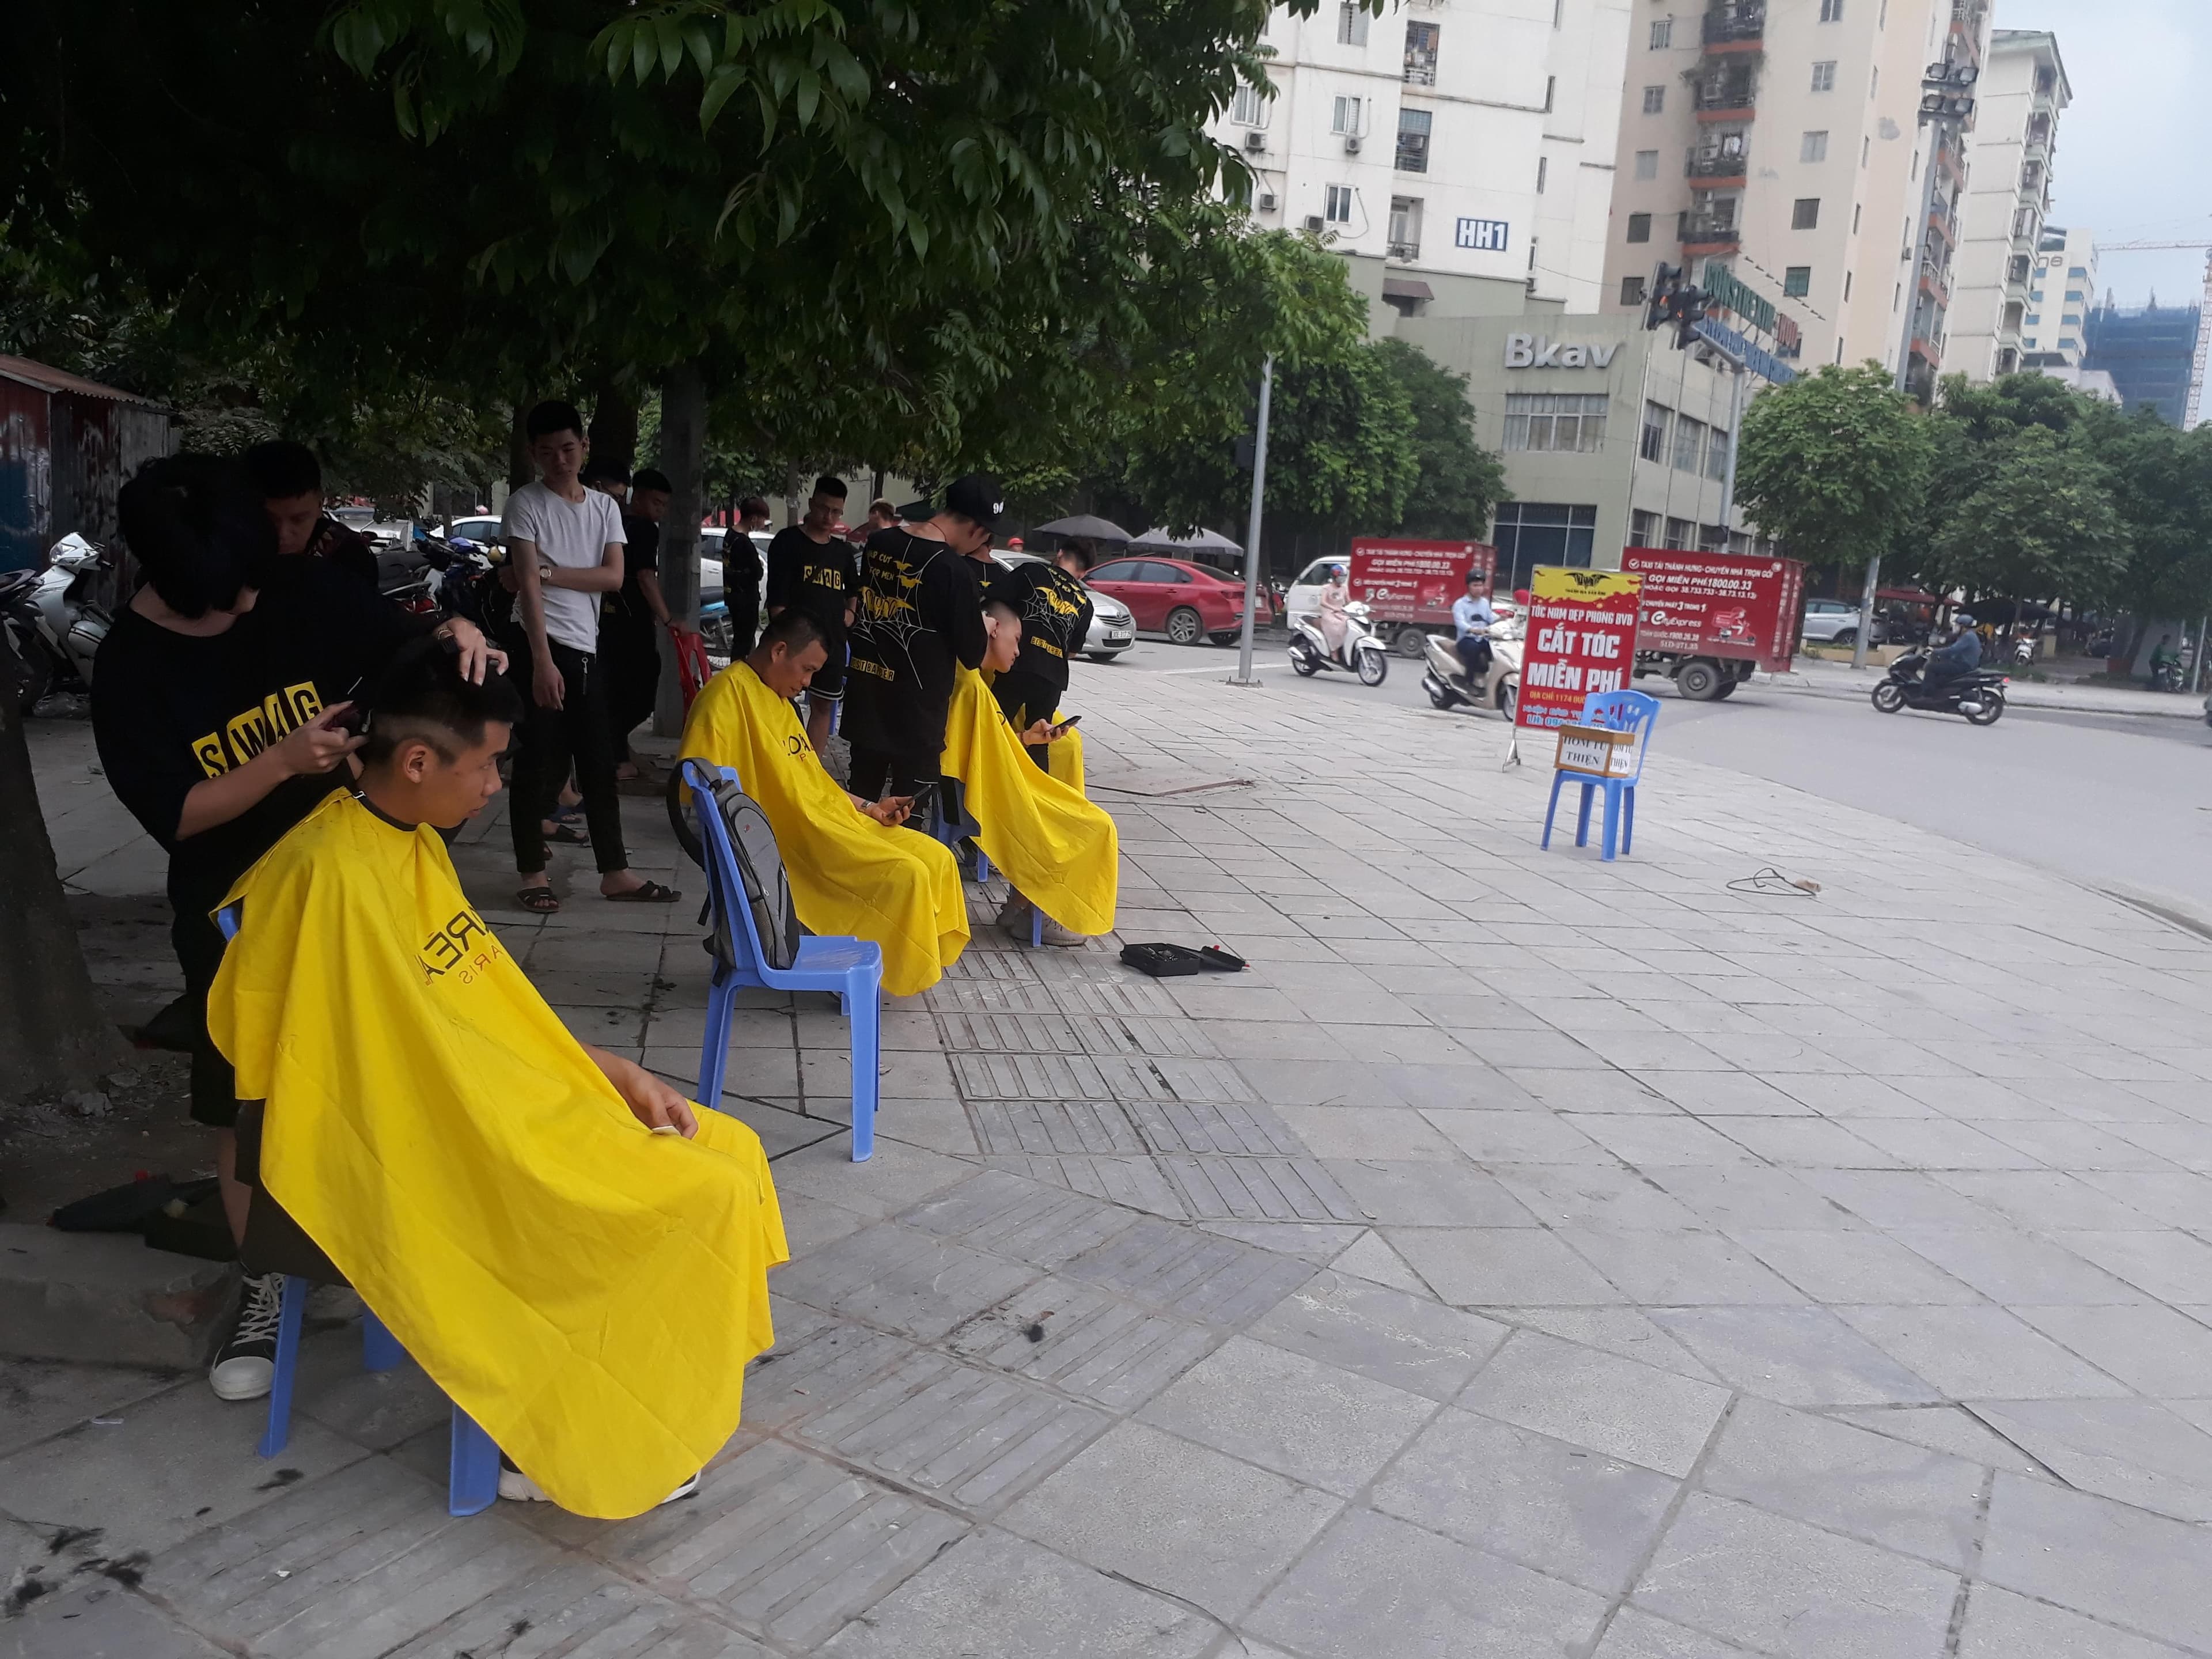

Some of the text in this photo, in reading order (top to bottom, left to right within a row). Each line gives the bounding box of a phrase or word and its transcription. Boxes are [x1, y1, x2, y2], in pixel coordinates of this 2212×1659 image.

[1458, 218, 1506, 251] HH1
[1505, 332, 1621, 369] Bkav
[879, 553, 893, 564] CUT
[881, 571, 895, 581] MEN
[1649, 574, 1665, 584] GỌI
[1547, 607, 1566, 620] NAM
[1585, 611, 1614, 624] PHONG
[1677, 602, 1684, 611] 3
[1537, 622, 1620, 660] CẮT TÓC
[1527, 658, 1623, 694] MIỄN PHÍ
[194, 682, 323, 778] SWAG
